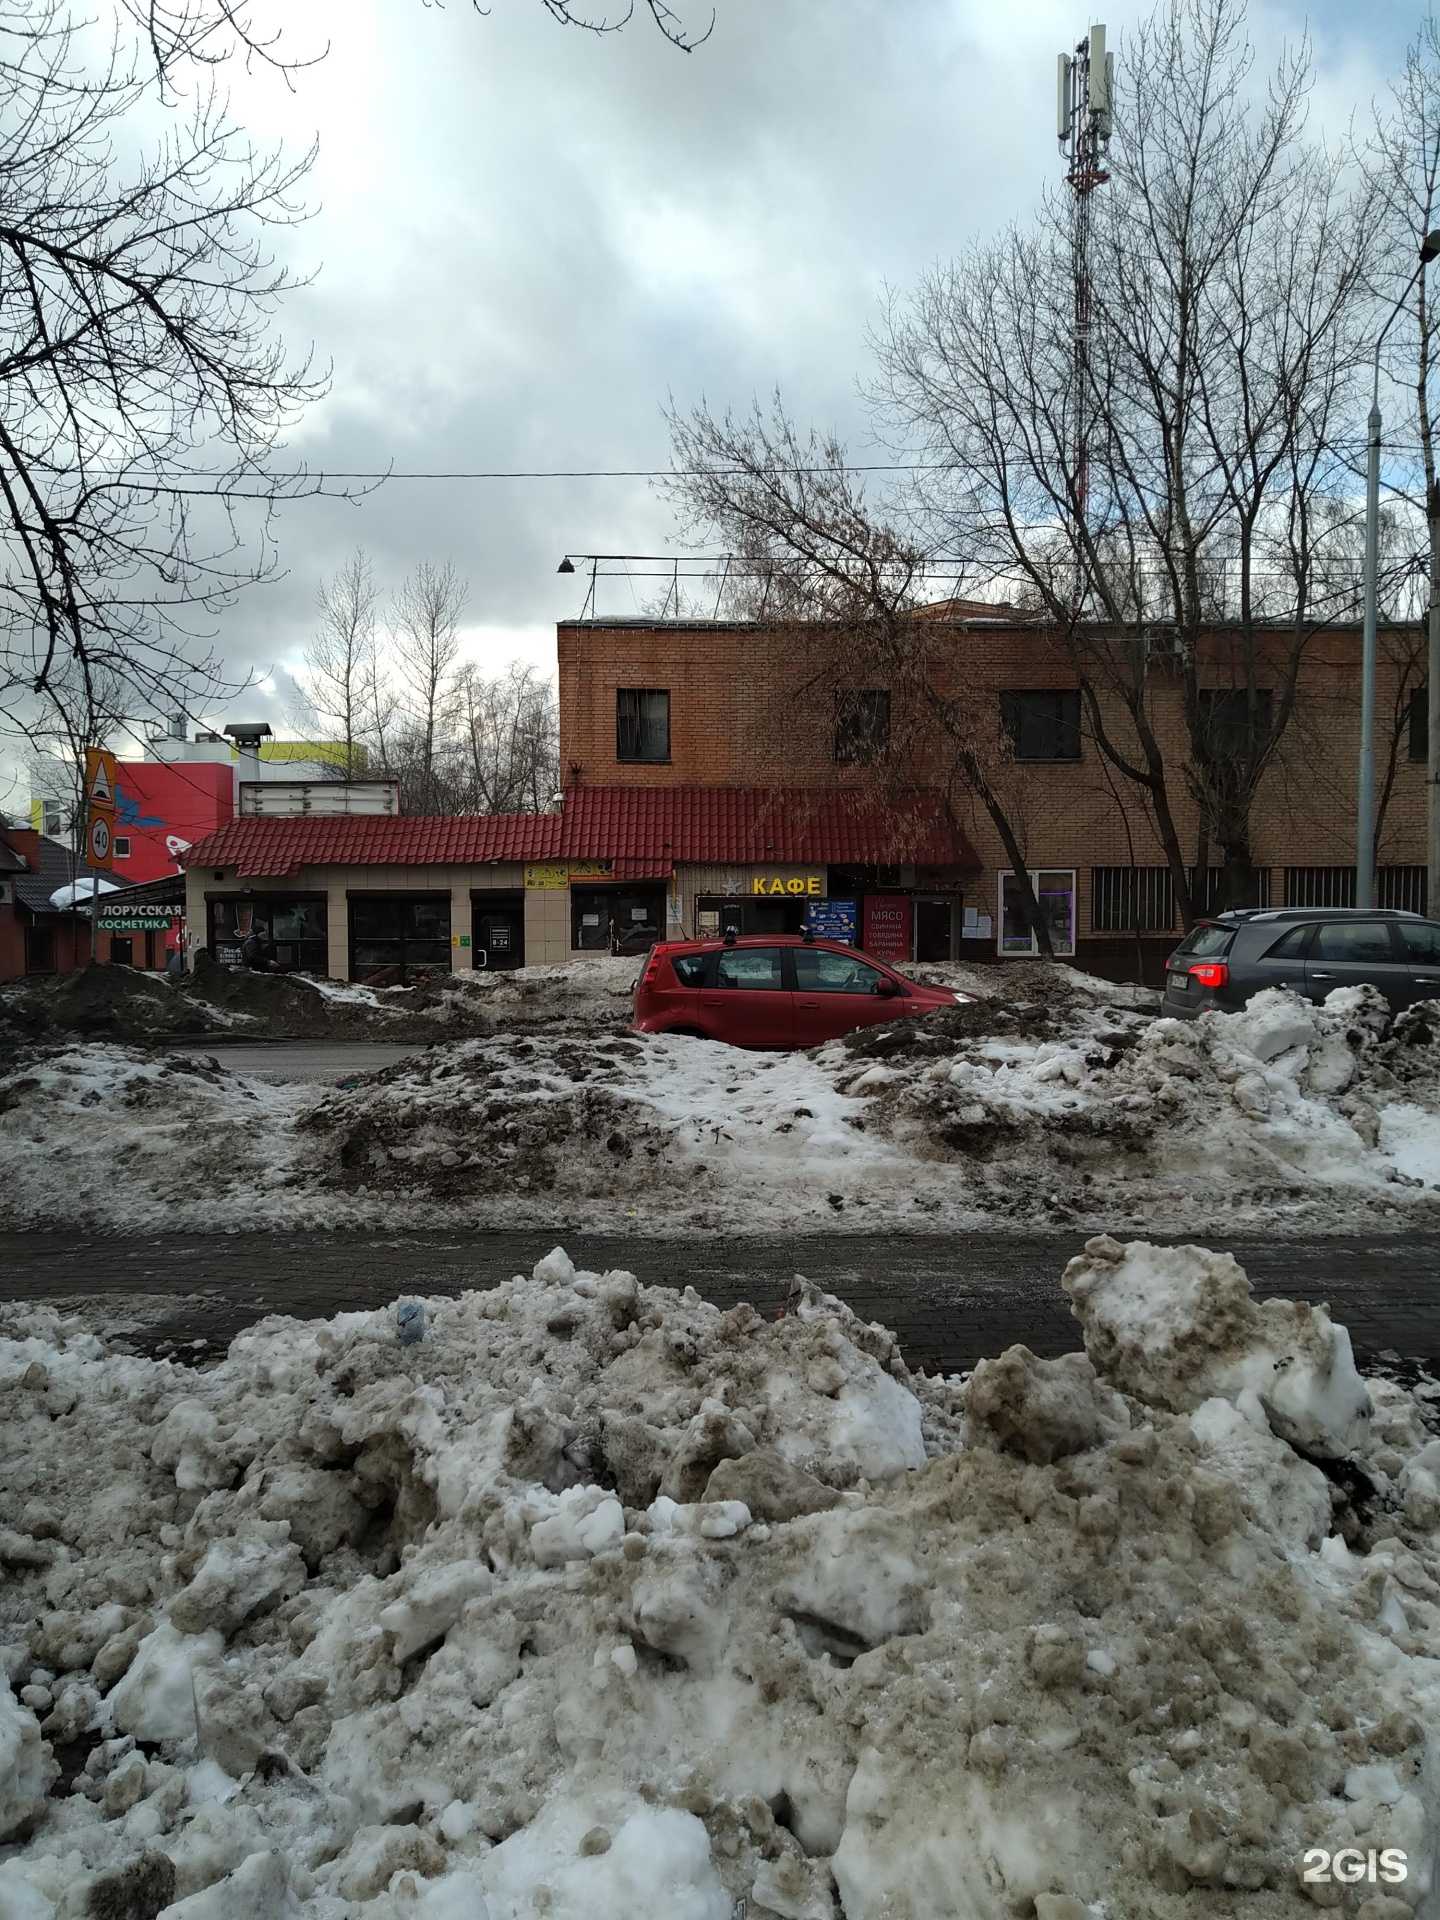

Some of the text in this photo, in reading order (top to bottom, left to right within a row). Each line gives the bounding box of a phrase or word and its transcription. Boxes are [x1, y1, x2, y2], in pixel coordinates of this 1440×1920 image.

[94, 831, 107, 849] 40
[752, 877, 821, 895] КАФЕ
[871, 911, 904, 921] МЯСО
[97, 919, 169, 929] КОСМЕТИКА
